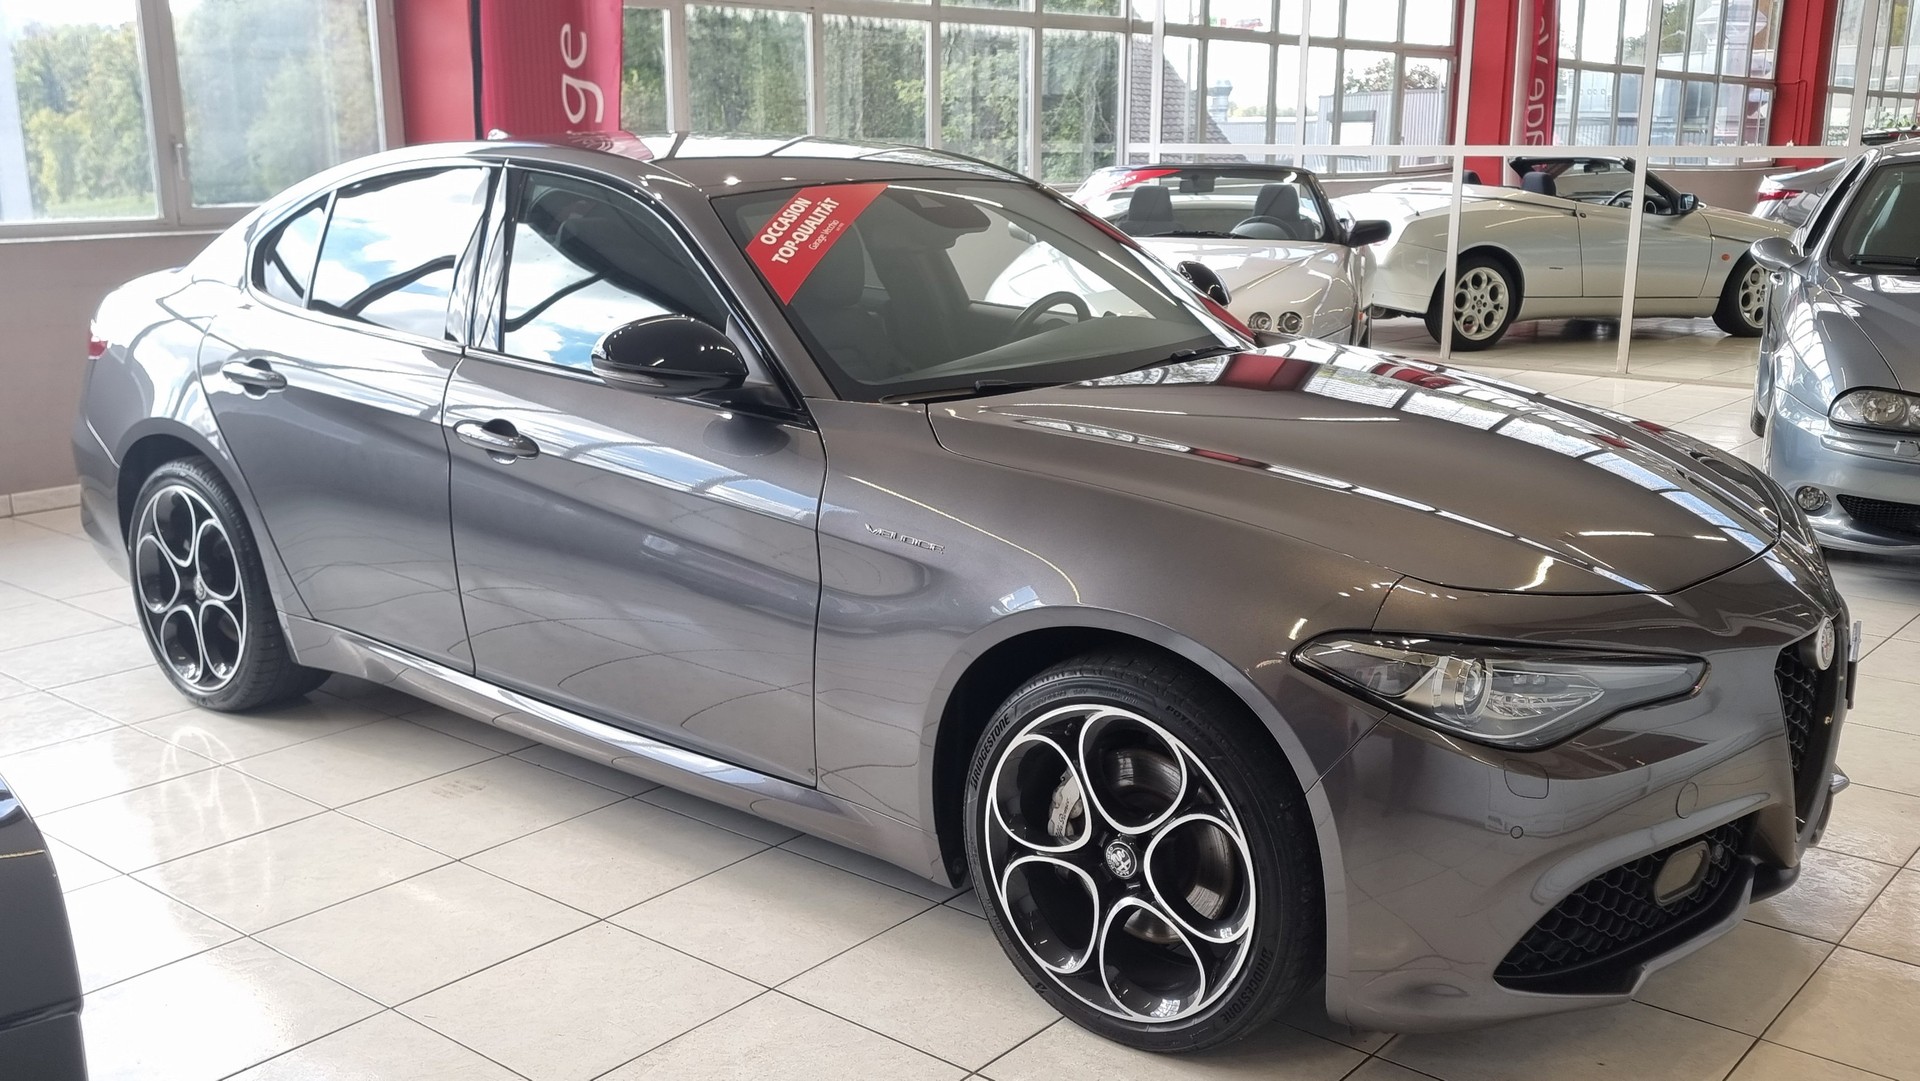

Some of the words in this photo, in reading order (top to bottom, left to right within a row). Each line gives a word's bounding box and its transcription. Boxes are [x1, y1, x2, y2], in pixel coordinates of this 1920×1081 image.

[760, 197, 812, 245] OCCASION
[771, 197, 840, 264] TOP-QUALITÄT
[808, 233, 827, 250] Garage
[969, 712, 1012, 791] BRIDGESTONE
[1222, 945, 1274, 1025] BRIDGESTONE
